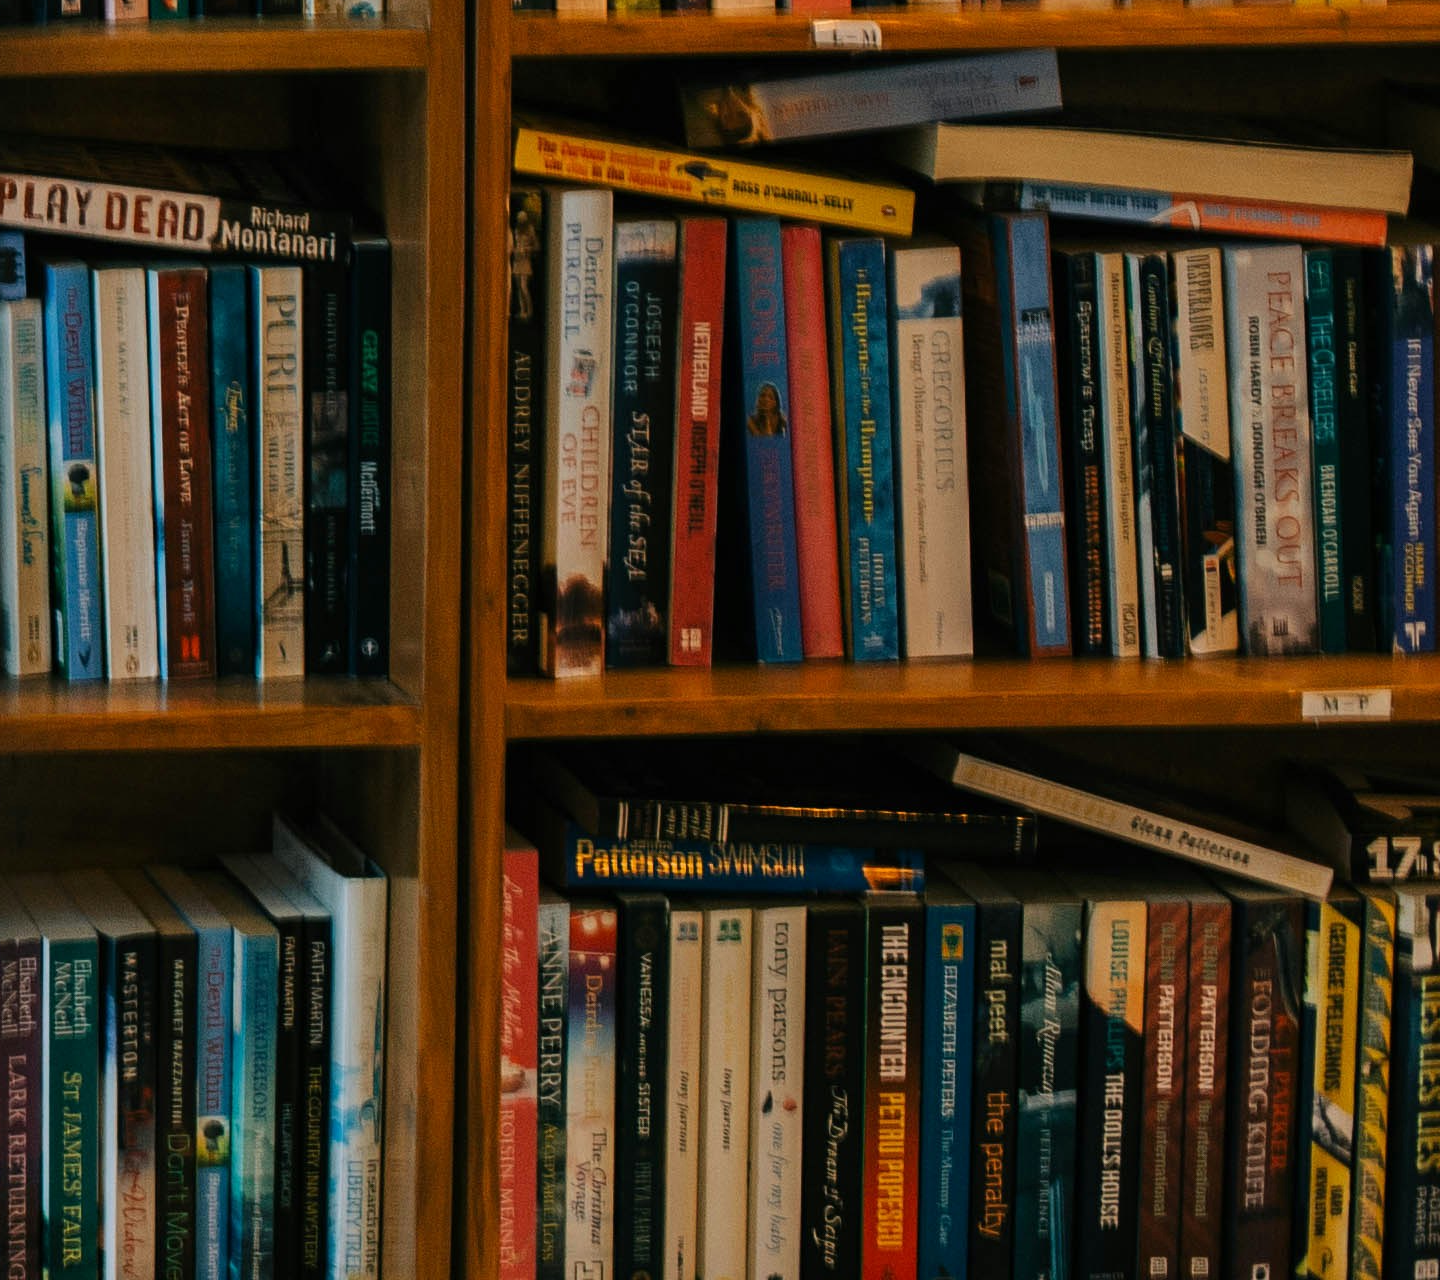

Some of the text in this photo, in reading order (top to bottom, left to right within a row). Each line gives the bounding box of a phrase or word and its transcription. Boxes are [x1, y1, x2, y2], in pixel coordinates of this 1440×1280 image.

[105, 191, 203, 240] DEAD
[221, 222, 335, 261] Montanari
[251, 206, 308, 231] Richard
[1267, 272, 1303, 588] PEACE BREAKS OUT
[538, 930, 563, 1106] ANNE PERRY
[878, 923, 909, 1079] THE ENCOUNTER
